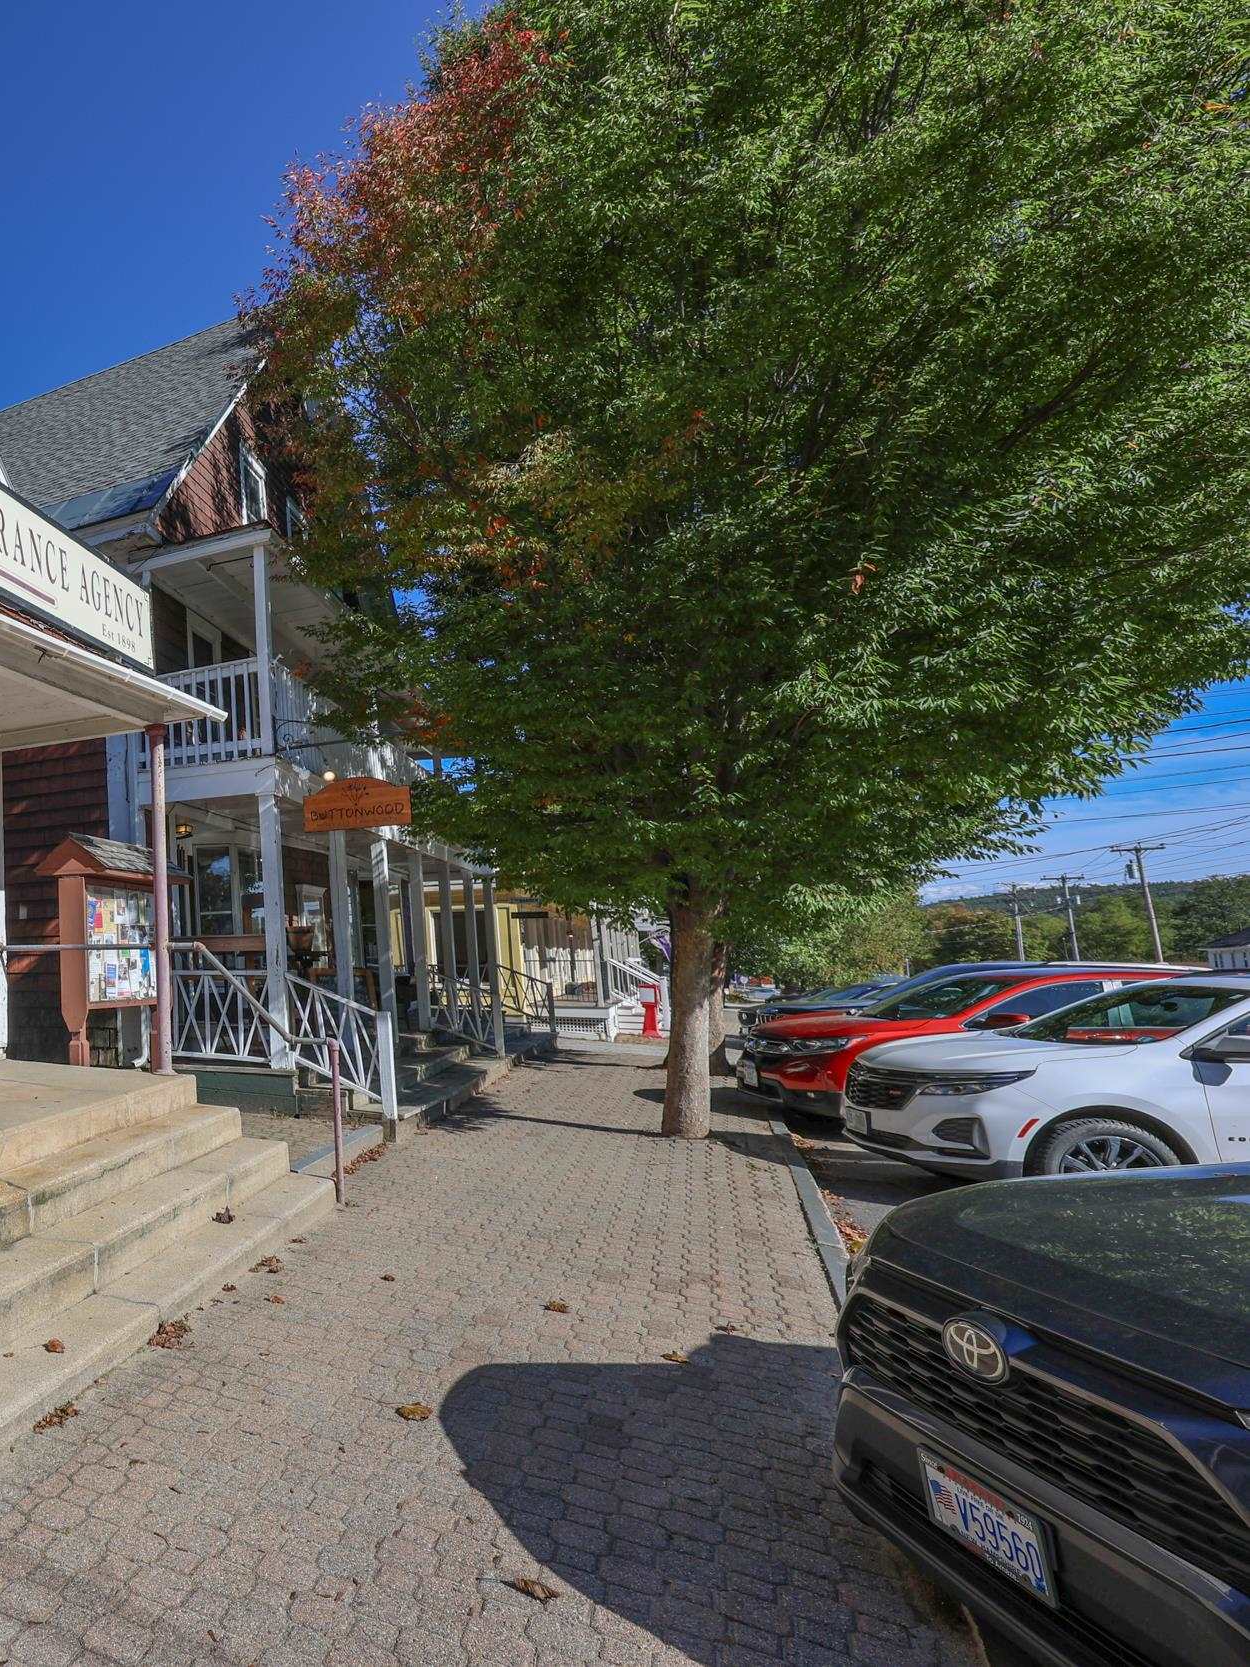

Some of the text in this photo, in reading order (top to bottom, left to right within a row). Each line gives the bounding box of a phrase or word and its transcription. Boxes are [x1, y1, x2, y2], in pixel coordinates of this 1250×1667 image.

[80, 563, 143, 638] AGENCY
[117, 632, 135, 652] 1898
[311, 802, 404, 821] BUTTONWOOD
[1017, 1513, 1033, 1531] 1924
[955, 1493, 1043, 1580] V59560
